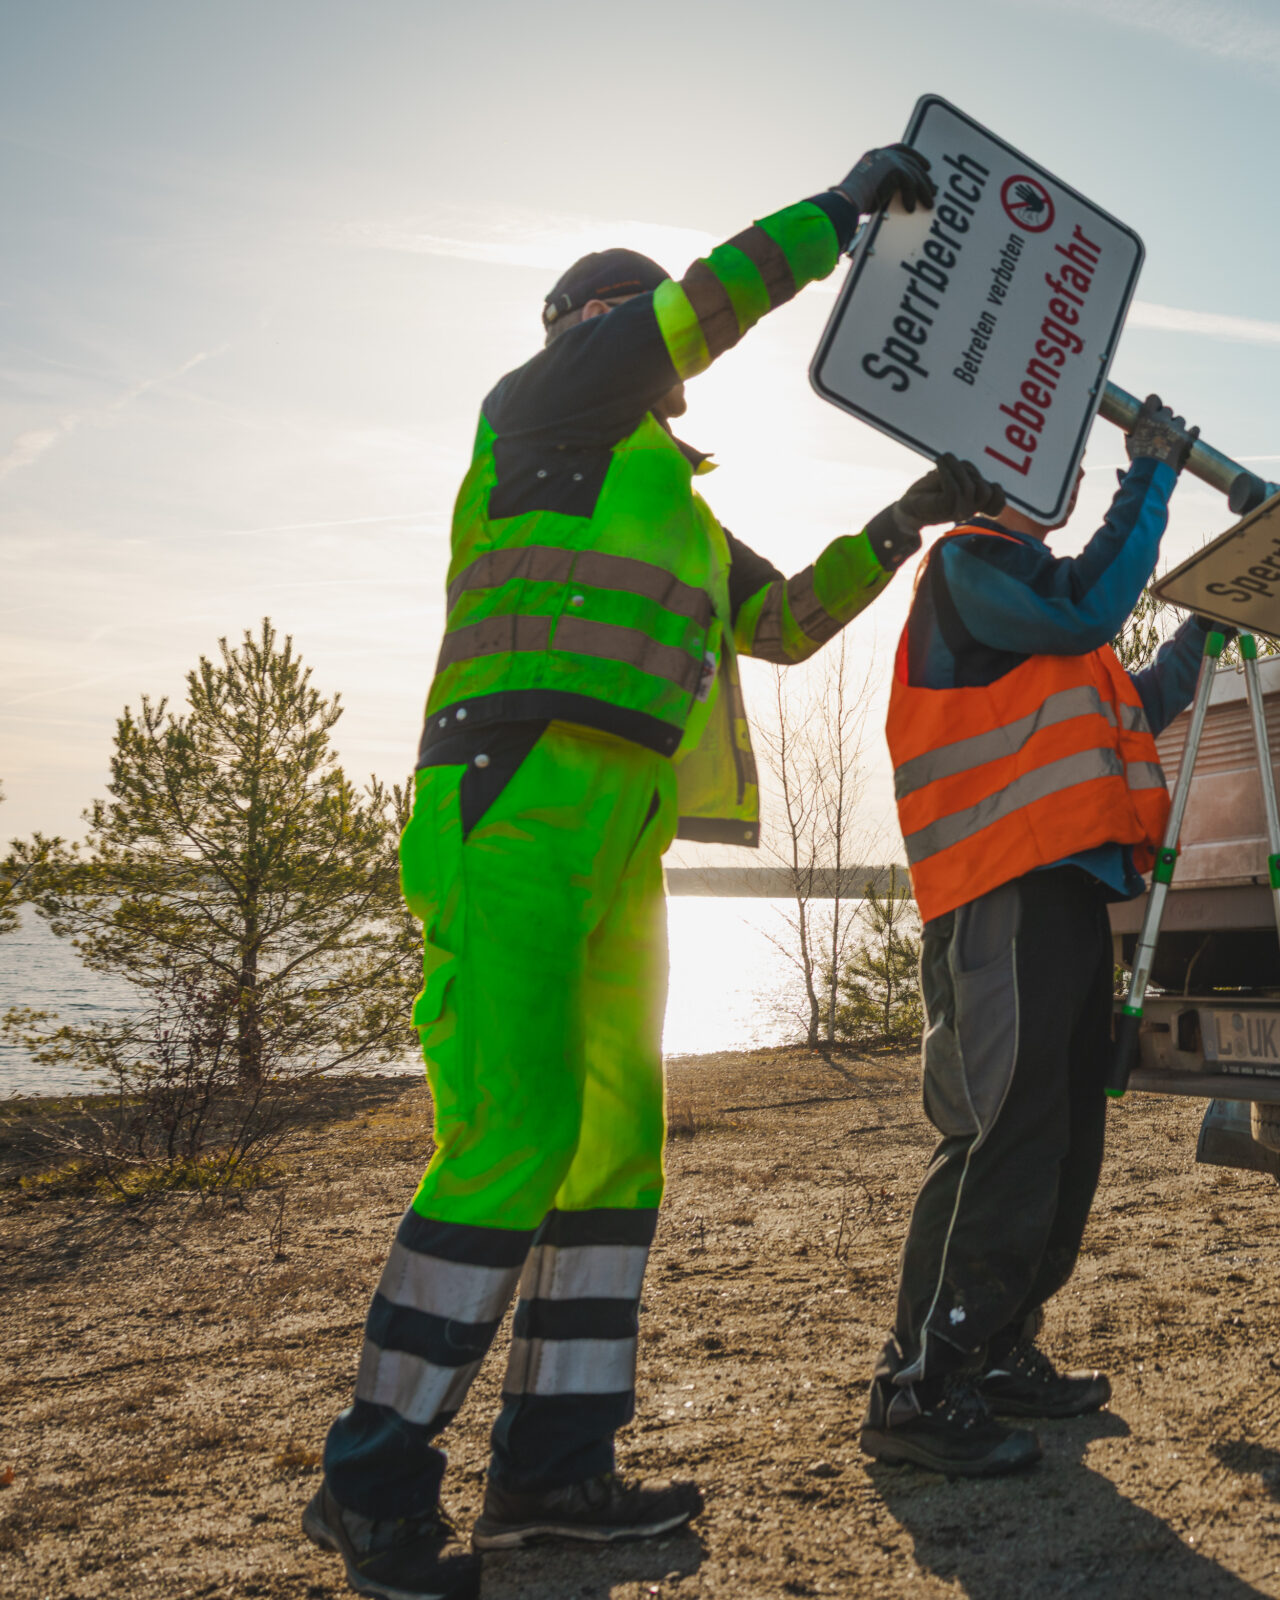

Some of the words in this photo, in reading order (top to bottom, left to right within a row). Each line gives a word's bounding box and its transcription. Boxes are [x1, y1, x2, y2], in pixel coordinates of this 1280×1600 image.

[861, 153, 990, 392] Sperrbereich
[953, 310, 998, 386] Betreten
[986, 233, 1026, 306] verboten
[984, 224, 1103, 476] Lebensgefahr
